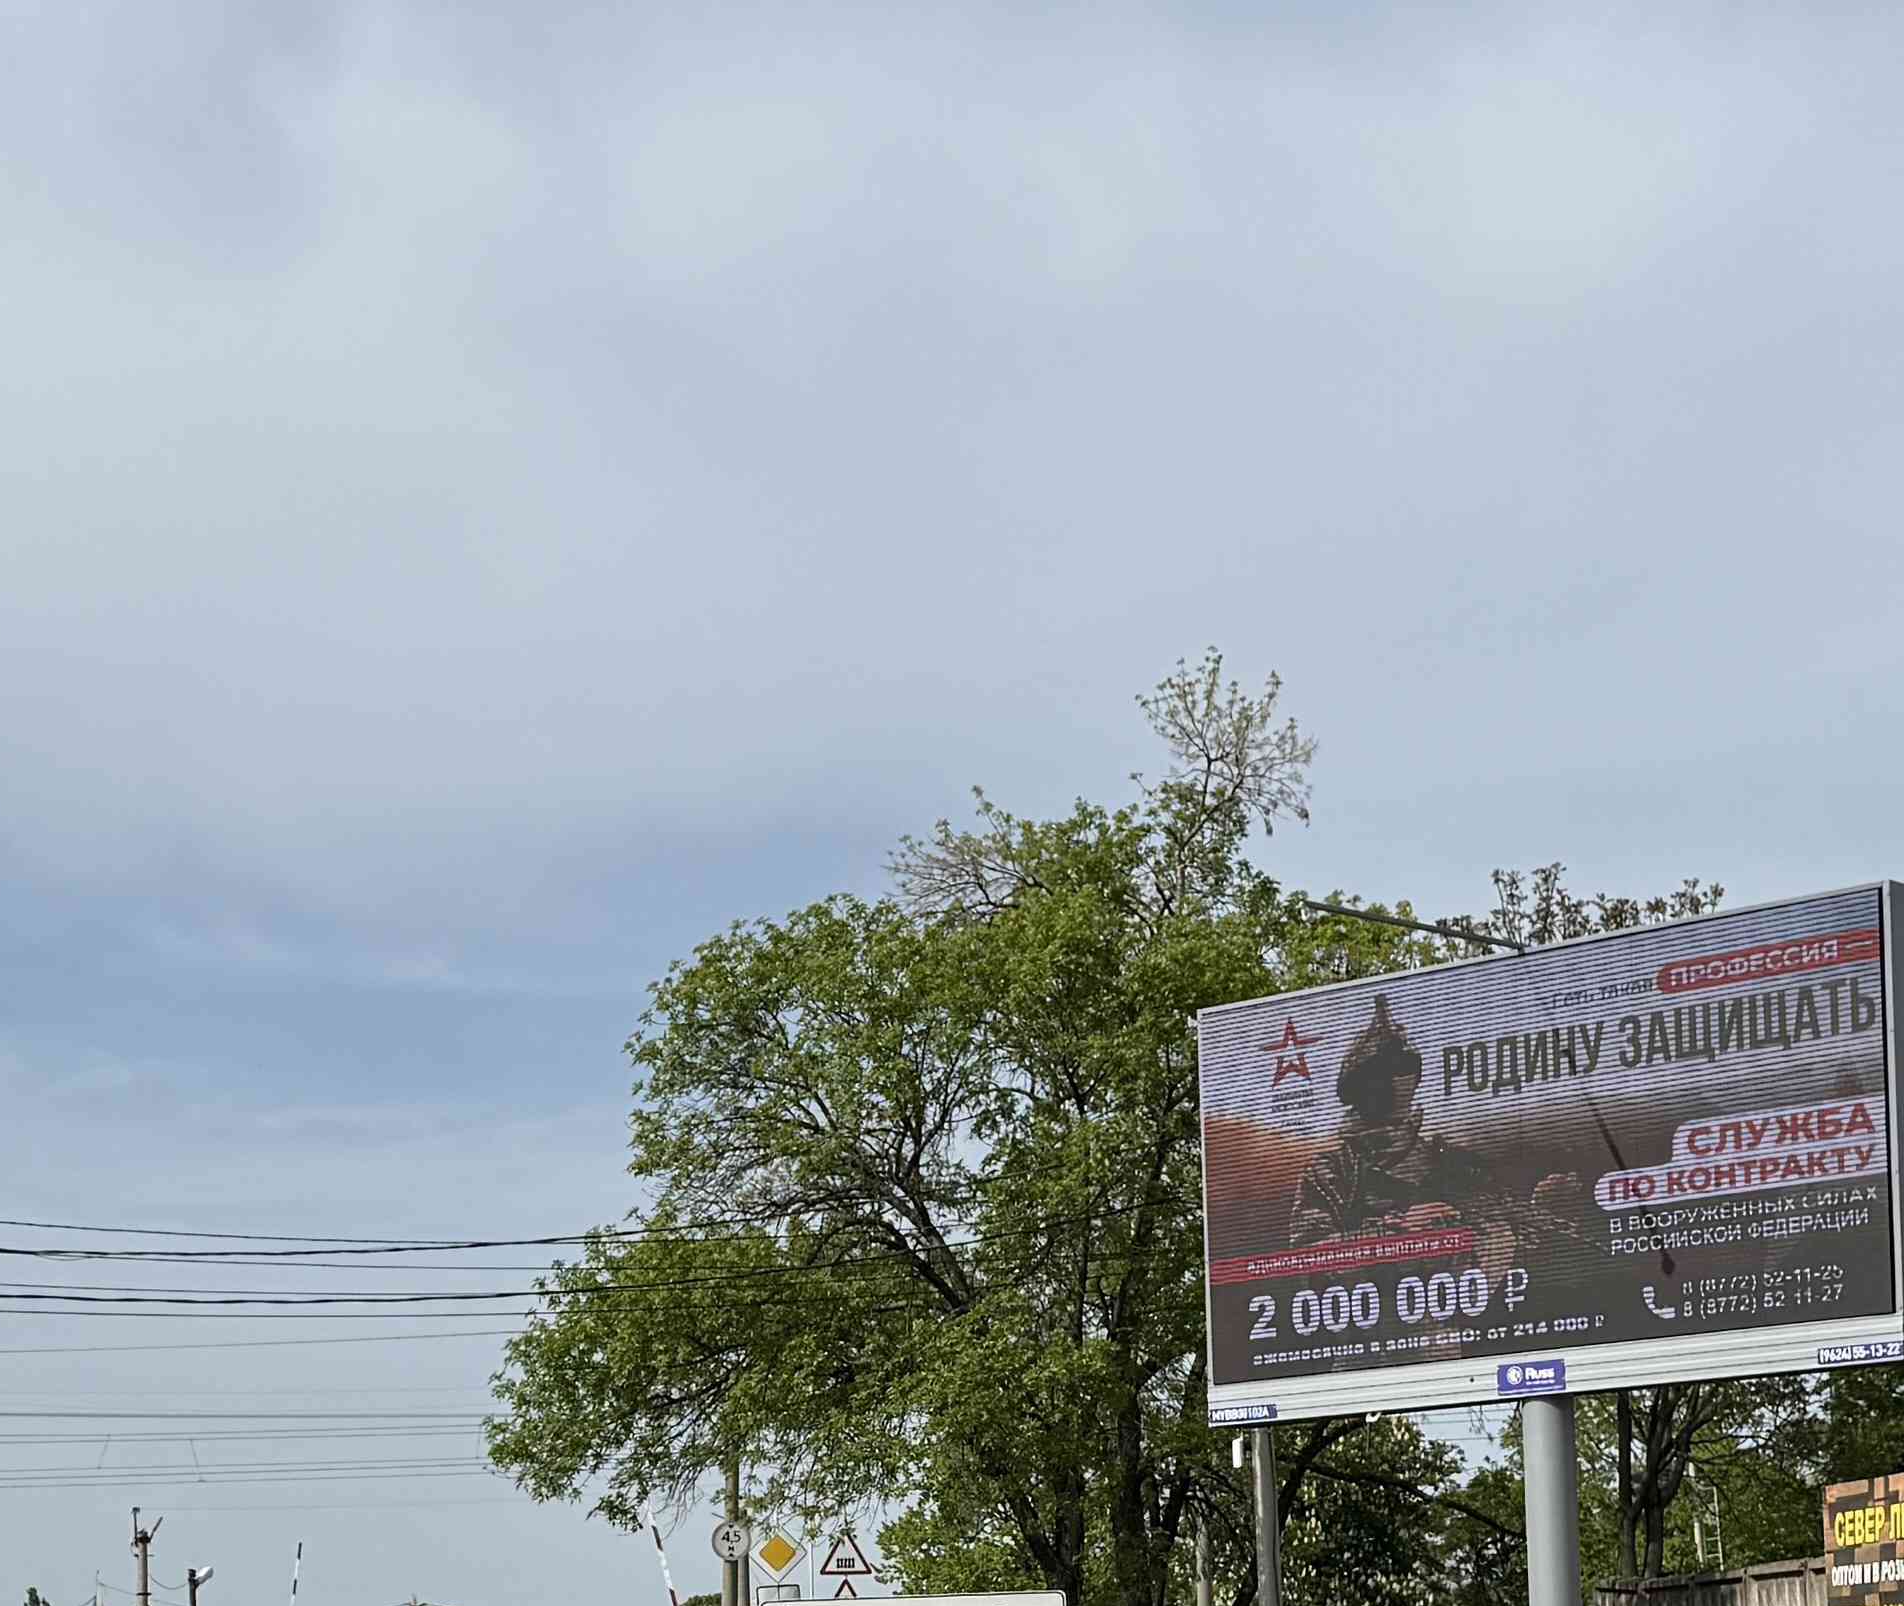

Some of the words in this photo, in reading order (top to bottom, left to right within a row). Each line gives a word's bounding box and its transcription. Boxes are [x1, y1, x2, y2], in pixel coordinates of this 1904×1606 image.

[1670, 939, 1839, 987] ПРОФЕССИЯ
[1443, 1021, 1604, 1097] РОДИНУ
[1618, 977, 1876, 1068] ЗАЩИЩАТЬ
[1687, 1102, 1876, 1156] СЛУЖБА
[1608, 1175, 1656, 1202] ПО
[1666, 1144, 1875, 1196] КОНТРАКТУ
[1609, 1217, 1623, 1234] В
[1628, 1197, 1796, 1232] ВООРУЖЕННЫХ
[1748, 1207, 1870, 1240] ФЕДЕРАЦИИ
[1249, 1295, 1277, 1341] 2
[1291, 1282, 1381, 1336] 000
[1396, 1268, 1489, 1324] 000
[1682, 1300, 1694, 1318] 8
[1699, 1294, 1758, 1320] (8772)
[1487, 1327, 1507, 1340] от
[1554, 1316, 1589, 1332] 000
[1834, 1505, 1886, 1547] СЕВЕР
[1831, 1563, 1863, 1587] ОПТОМ
